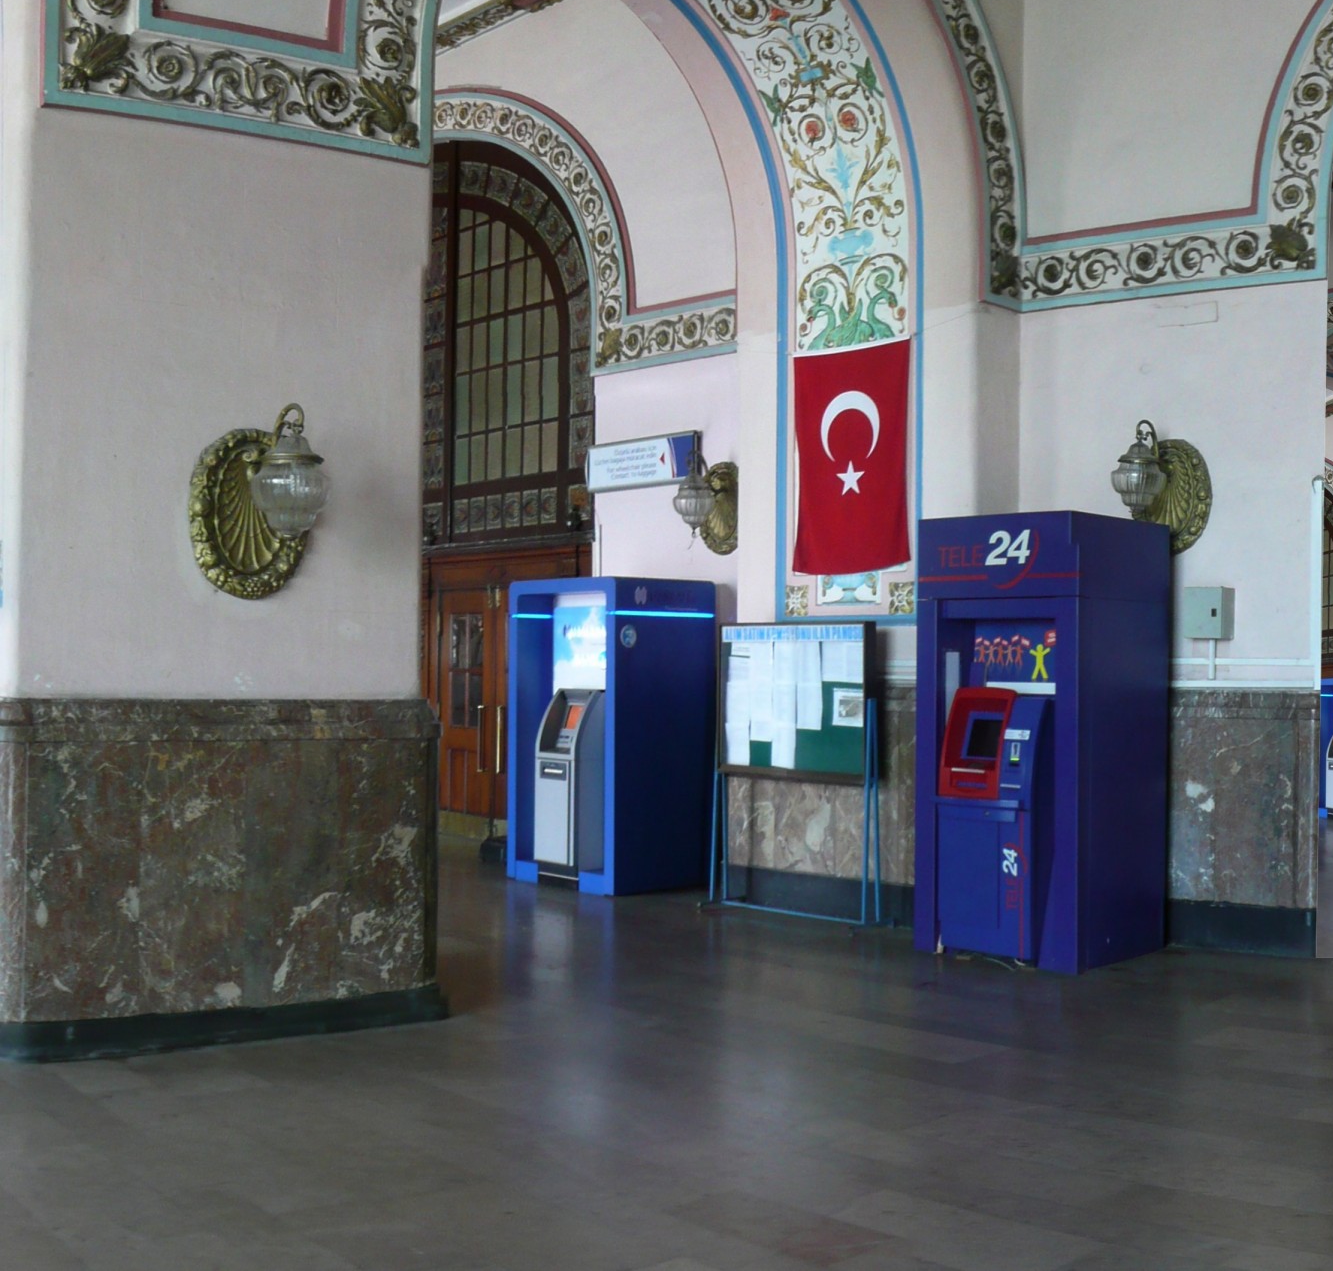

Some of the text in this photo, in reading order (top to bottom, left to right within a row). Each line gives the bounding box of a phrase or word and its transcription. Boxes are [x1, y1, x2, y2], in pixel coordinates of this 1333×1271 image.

[938, 529, 1031, 568] TELE 24
[1003, 848, 1018, 876] 24
